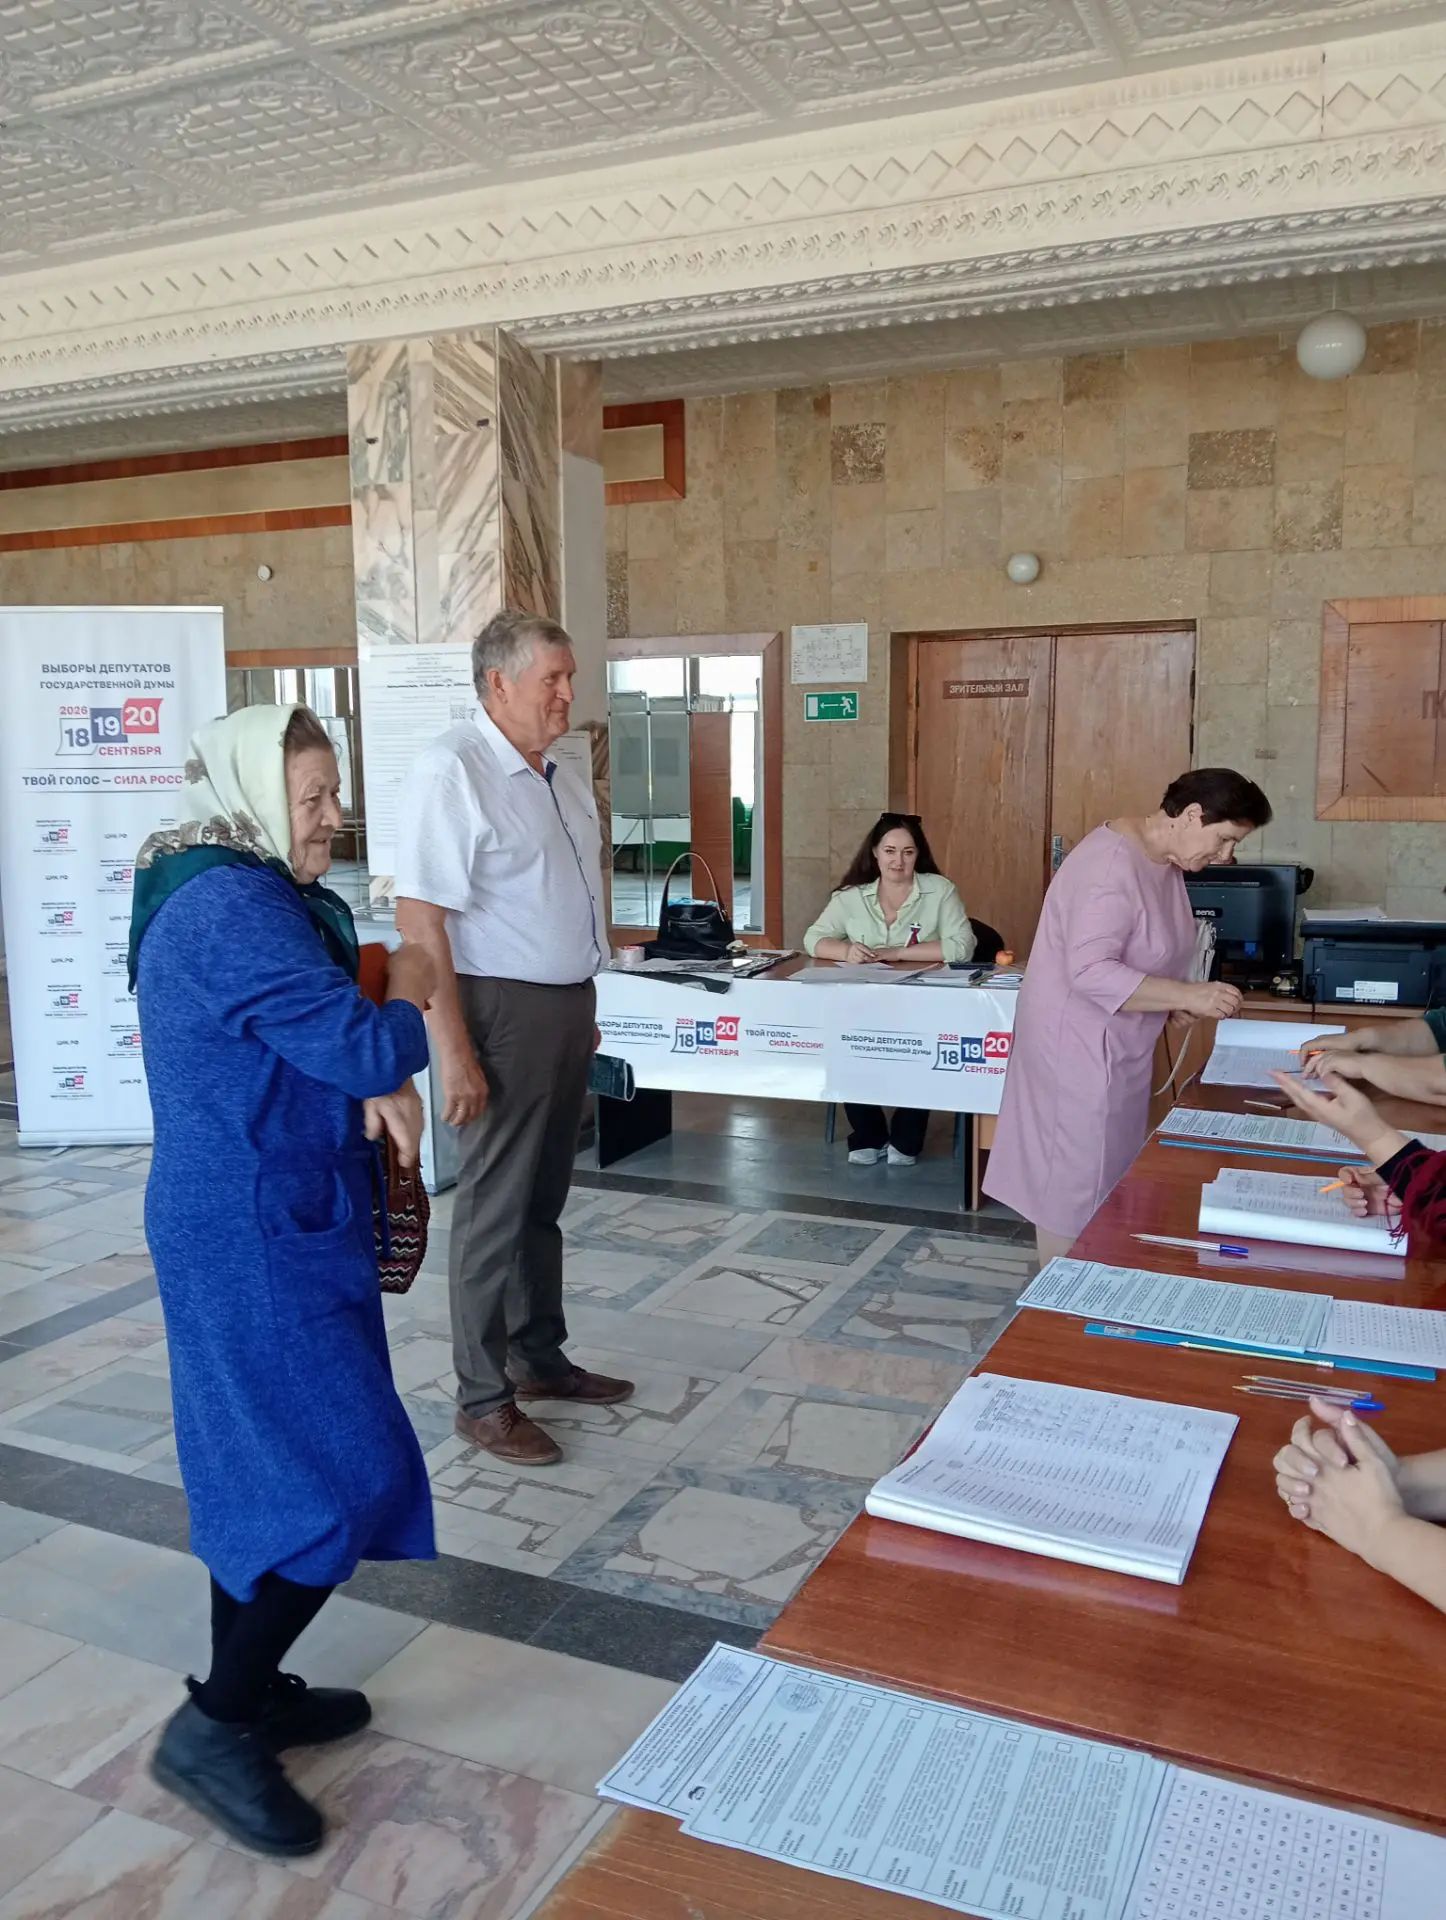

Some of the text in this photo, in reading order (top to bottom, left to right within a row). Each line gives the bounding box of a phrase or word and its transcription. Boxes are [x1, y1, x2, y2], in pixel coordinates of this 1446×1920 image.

[41, 663, 171, 674] ВЫБОРЫ ДЕПУТАТОВ
[40, 679, 175, 690] ГОСУДАРСТВЕННОЙ ДУМЫ
[949, 683, 1024, 694] ЗРИТЕЛЬНЫЙ ЗАЛ
[59, 705, 88, 715] 2026
[64, 706, 157, 748] 18 19 20
[98, 746, 162, 756] СЕНТЯБРЯ
[22, 774, 56, 785] ТВОЙ
[59, 775, 100, 785] ГОЛОС
[114, 775, 147, 785] СИЛА
[150, 774, 183, 785] РОСС
[622, 1022, 663, 1031] ДЕПУТАТОВ
[676, 1018, 694, 1026] 2026
[678, 1021, 737, 1048] 18 19 20
[745, 1029, 766, 1037] ТВОЙ
[766, 1030, 792, 1038] ГОЛОС
[937, 1033, 959, 1041] 2026
[768, 1039, 790, 1047] СИЛА
[841, 1034, 923, 1047] ВЫБОРЫ ДЕПУТАТОВ
[698, 1047, 739, 1056] СЕНТЯБРЯ
[850, 1044, 932, 1056] ГОСУДАРСТВЕННОЙ ДУМЫ
[941, 1036, 1010, 1065] 18 19 20
[964, 1065, 1006, 1075] СЕНТЯБР
